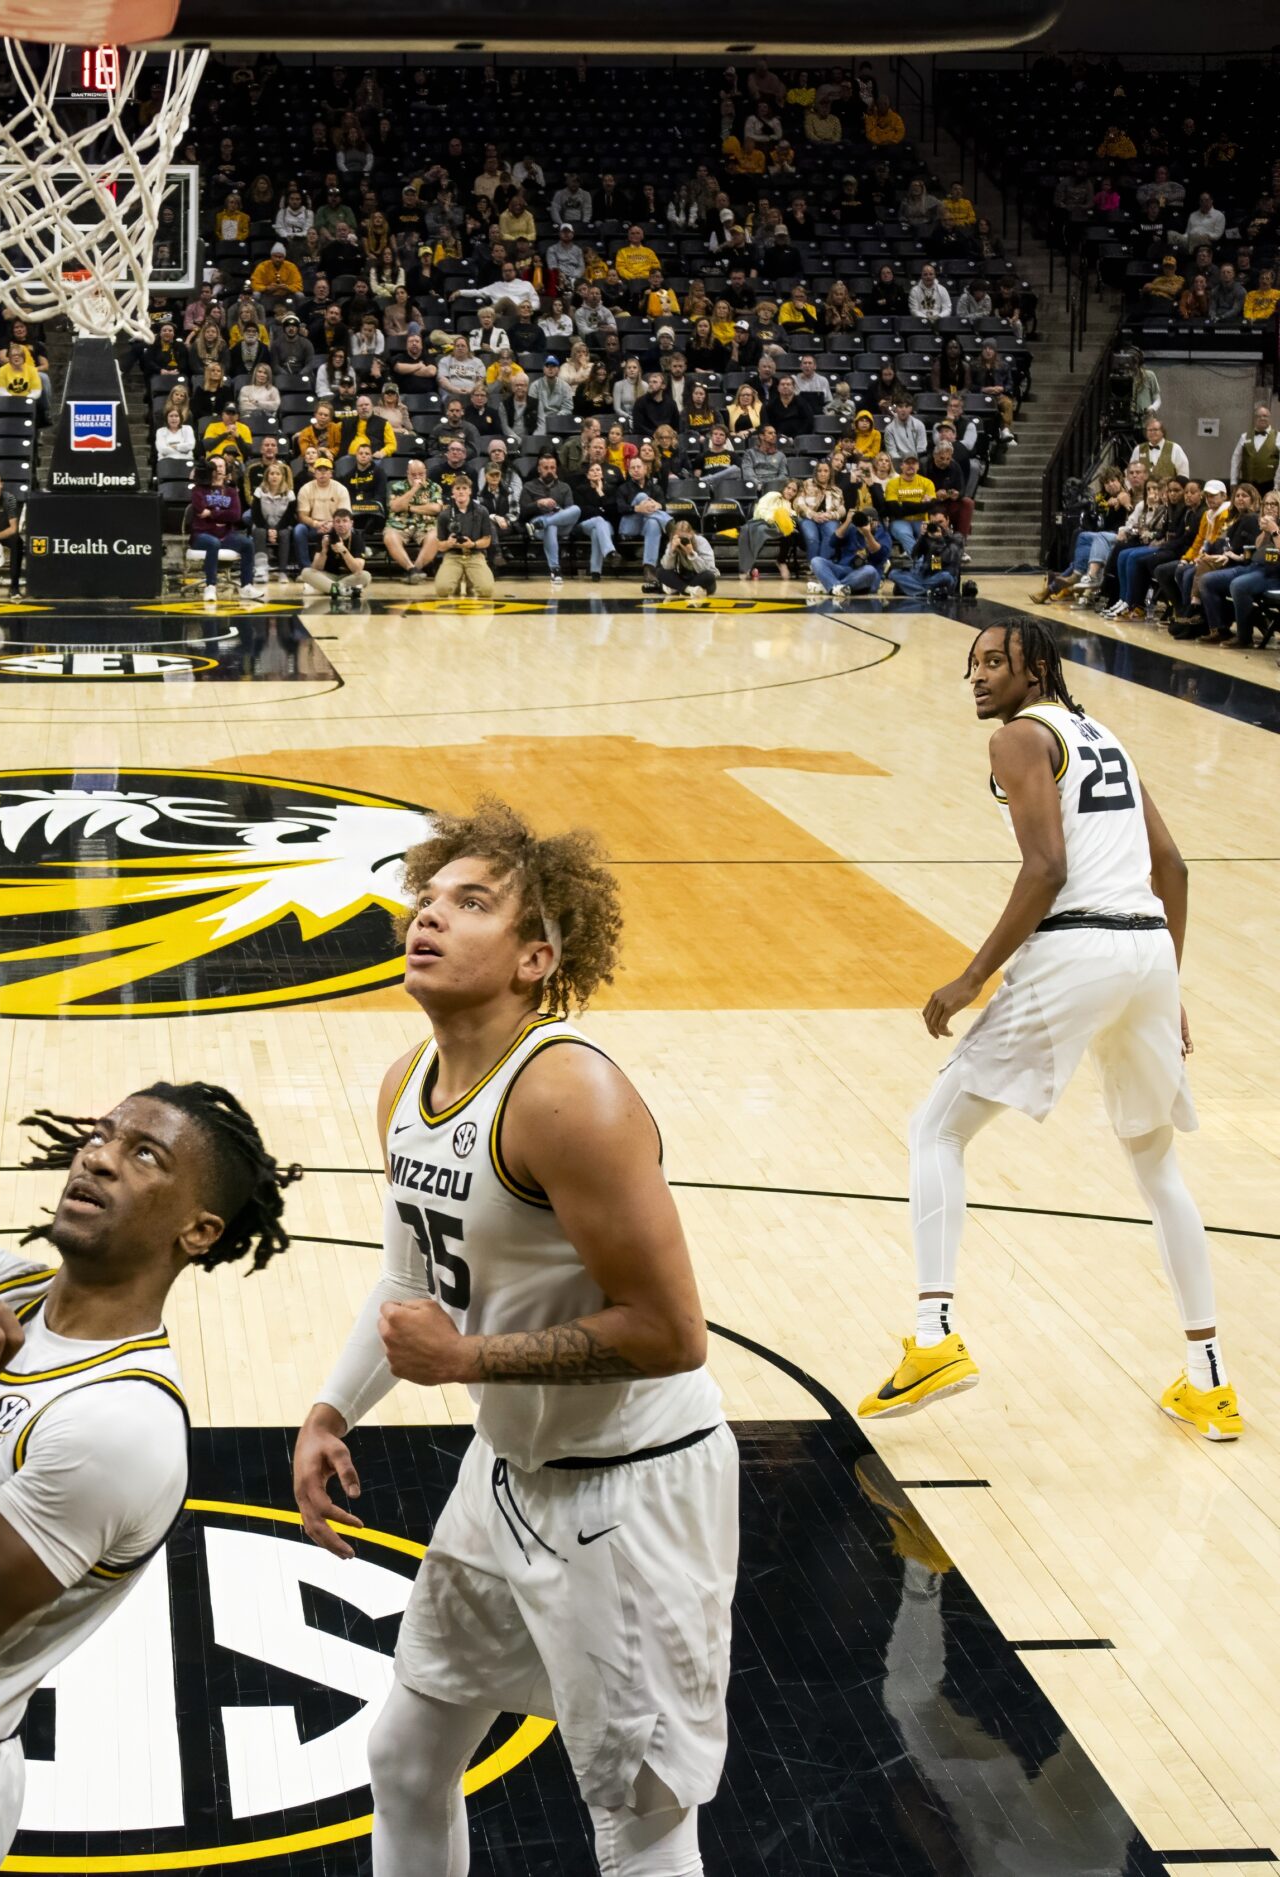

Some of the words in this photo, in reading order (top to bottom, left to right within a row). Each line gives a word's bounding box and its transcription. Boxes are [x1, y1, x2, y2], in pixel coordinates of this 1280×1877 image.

[74, 414, 112, 422] SHELTER
[52, 538, 109, 555] Health
[112, 538, 152, 555] Care
[1077, 746, 1136, 814] 23
[391, 1153, 473, 1202] MIZZOU
